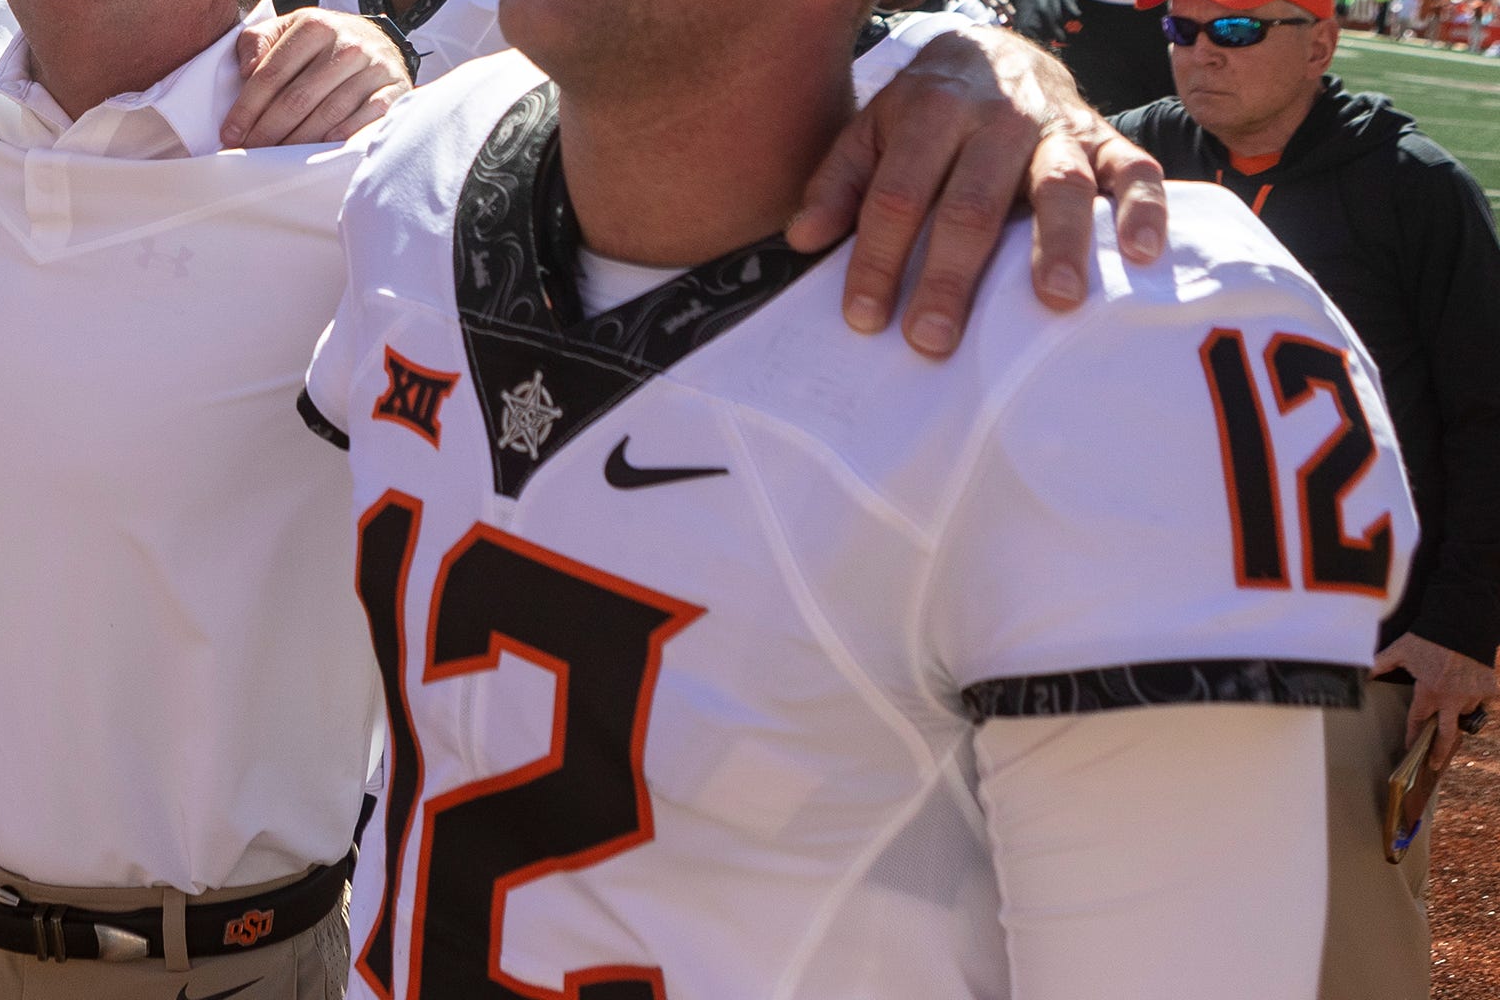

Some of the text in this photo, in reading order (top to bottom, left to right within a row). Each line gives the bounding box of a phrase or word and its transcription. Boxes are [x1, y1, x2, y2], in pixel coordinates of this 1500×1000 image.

[1198, 327, 1394, 600] 12
[355, 488, 709, 1000] 12
[223, 909, 275, 946] OSU
